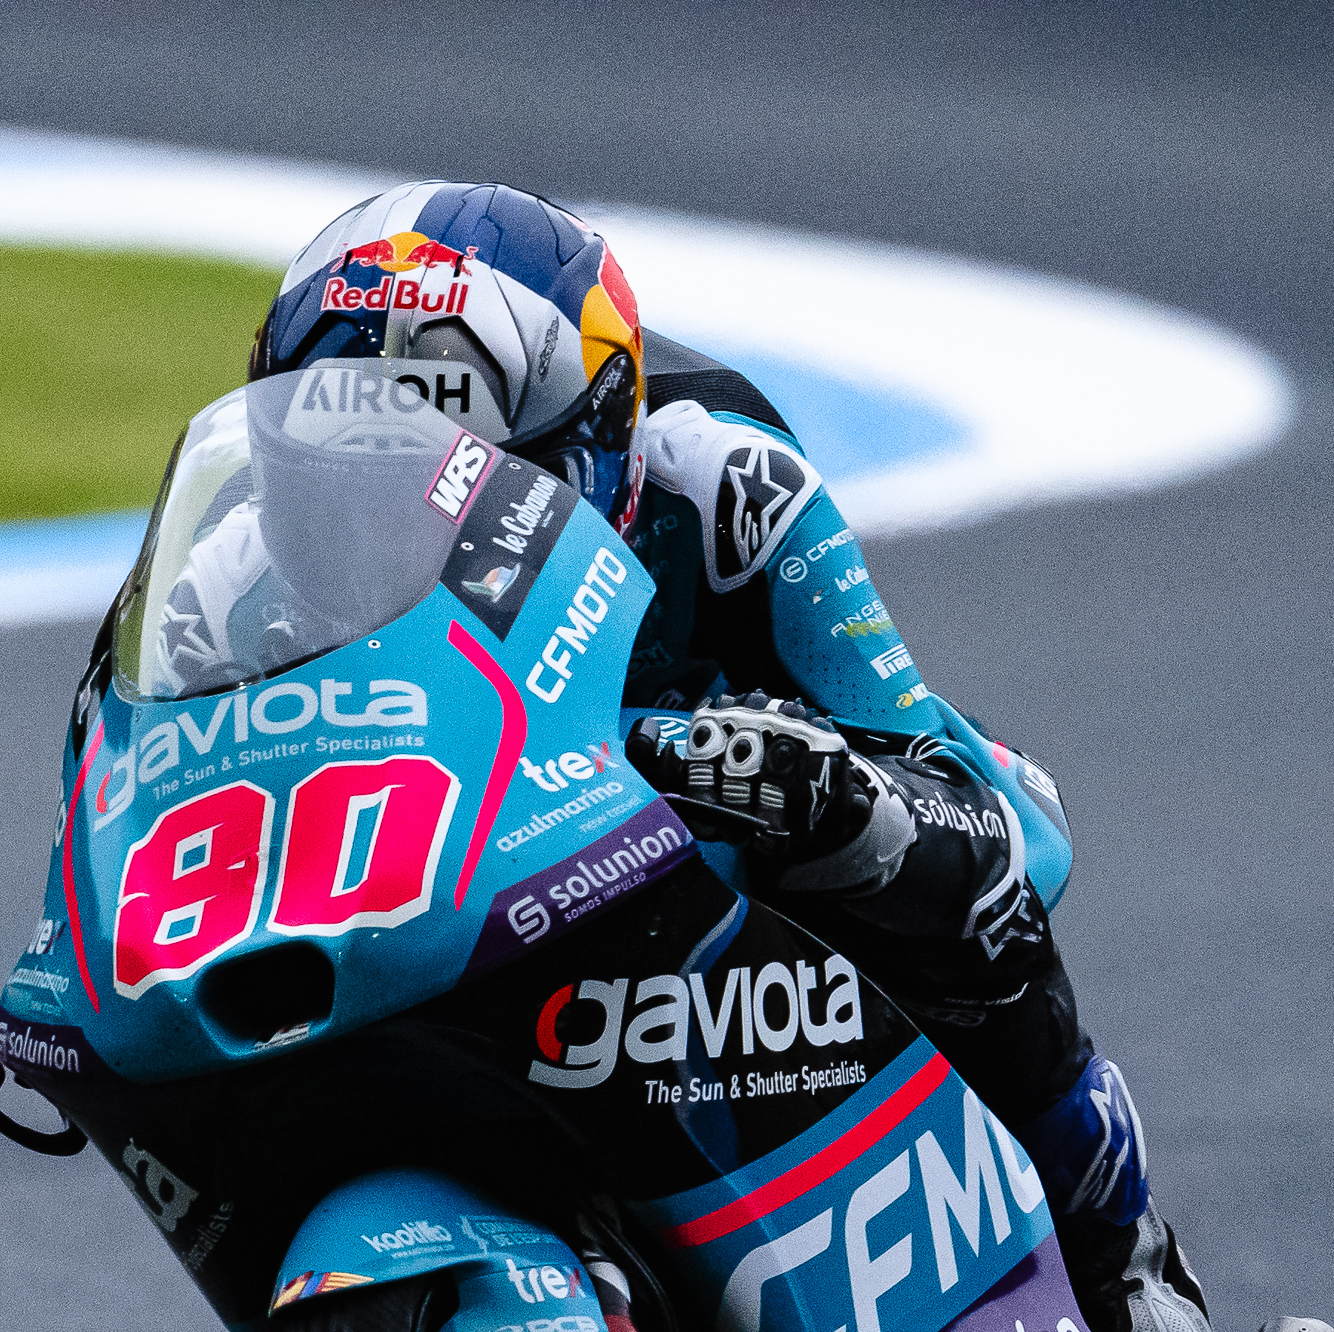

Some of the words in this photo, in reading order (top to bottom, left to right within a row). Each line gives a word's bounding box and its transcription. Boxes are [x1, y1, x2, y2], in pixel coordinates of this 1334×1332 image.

[321, 277, 391, 312] Red
[394, 278, 469, 315] Bull
[302, 369, 471, 414] AIROH
[430, 434, 488, 517] WRS
[525, 546, 628, 704] CFMOTO
[830, 600, 885, 637] ANGE
[869, 643, 914, 680] PIRE
[94, 678, 429, 833] gaviota
[152, 779, 180, 801] The
[184, 763, 216, 787] Sun
[220, 755, 234, 772] &
[238, 739, 309, 767] Shutter
[316, 734, 425, 754] Specialists
[519, 741, 620, 792] trex
[496, 781, 624, 852] azulmarino
[913, 791, 1007, 840] solunion
[113, 753, 463, 1002] 80
[549, 825, 684, 910] solunion
[564, 895, 602, 923] SOMOS
[602, 871, 647, 900] IMPULSO
[527, 953, 864, 1089] gaviota
[8, 1026, 81, 1074] solunion
[645, 1079, 683, 1105] The
[689, 1077, 724, 1103] Sun
[730, 1073, 742, 1099] &
[746, 1069, 799, 1098] Shutter
[802, 1059, 867, 1095] Specialists
[505, 1258, 586, 1305] trex
